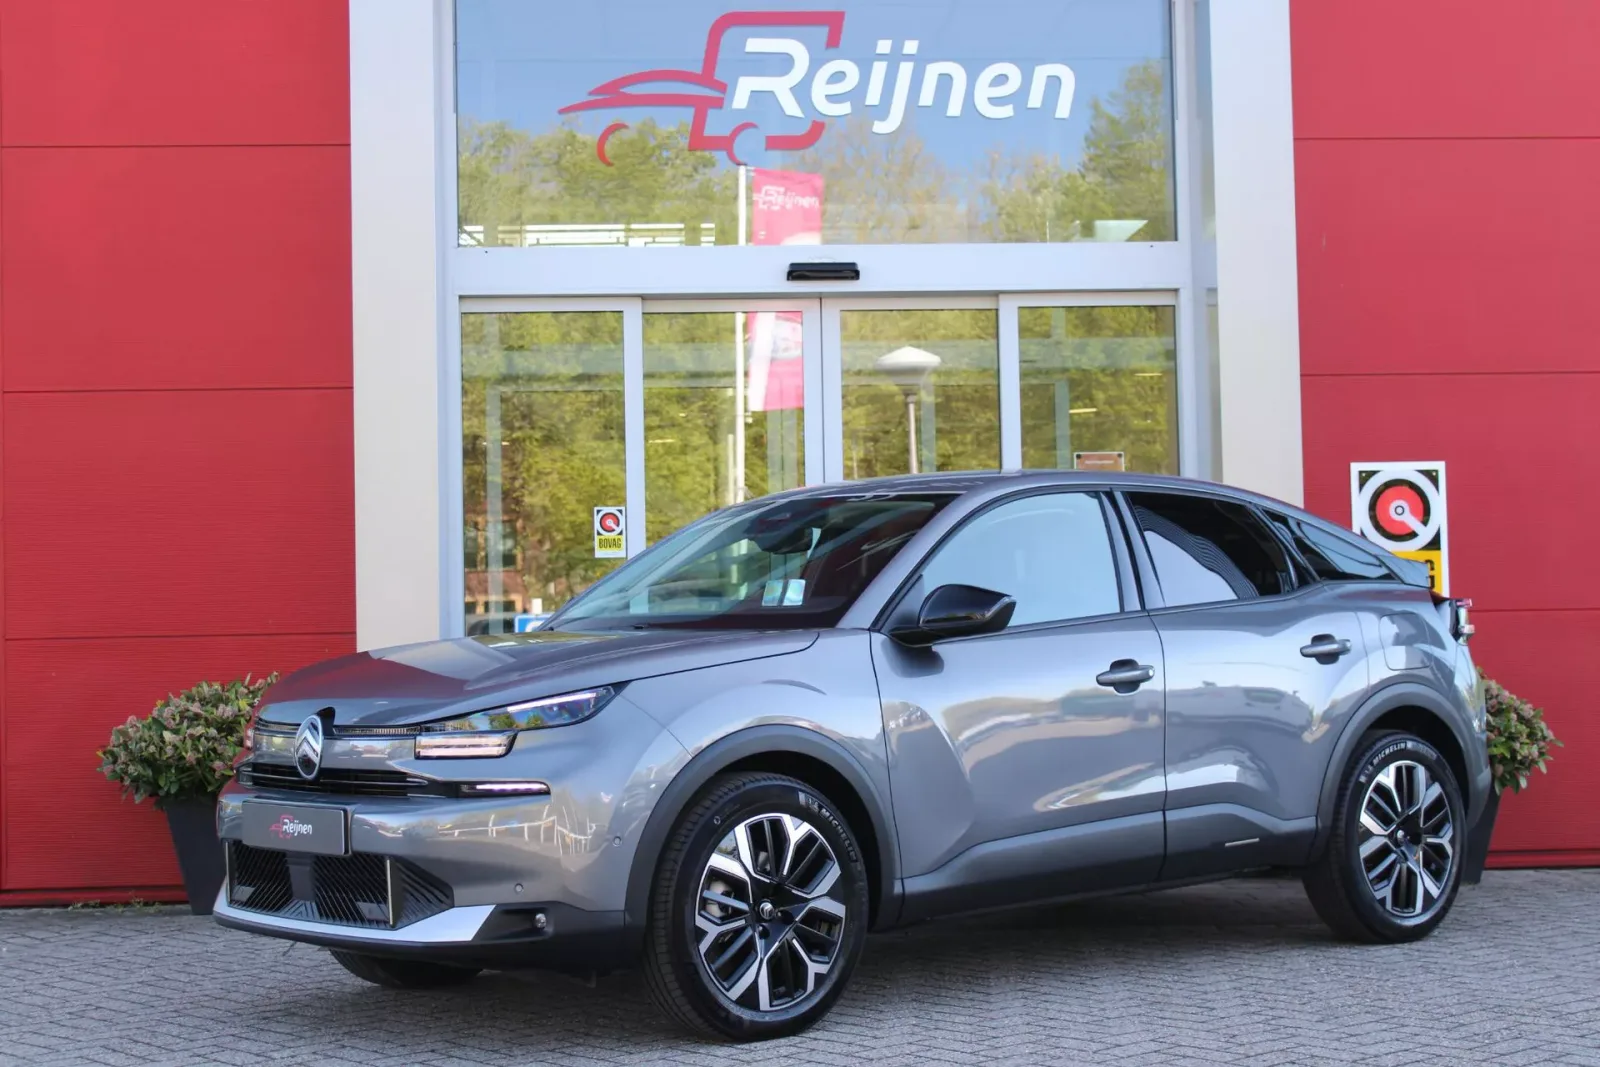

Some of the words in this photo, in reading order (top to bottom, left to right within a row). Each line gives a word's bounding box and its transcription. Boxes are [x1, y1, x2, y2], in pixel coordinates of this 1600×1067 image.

[732, 38, 1076, 134] Reijnen
[598, 538, 622, 549] BOVAG
[1373, 742, 1406, 766] MICHELIN
[283, 819, 312, 836] Reijnen
